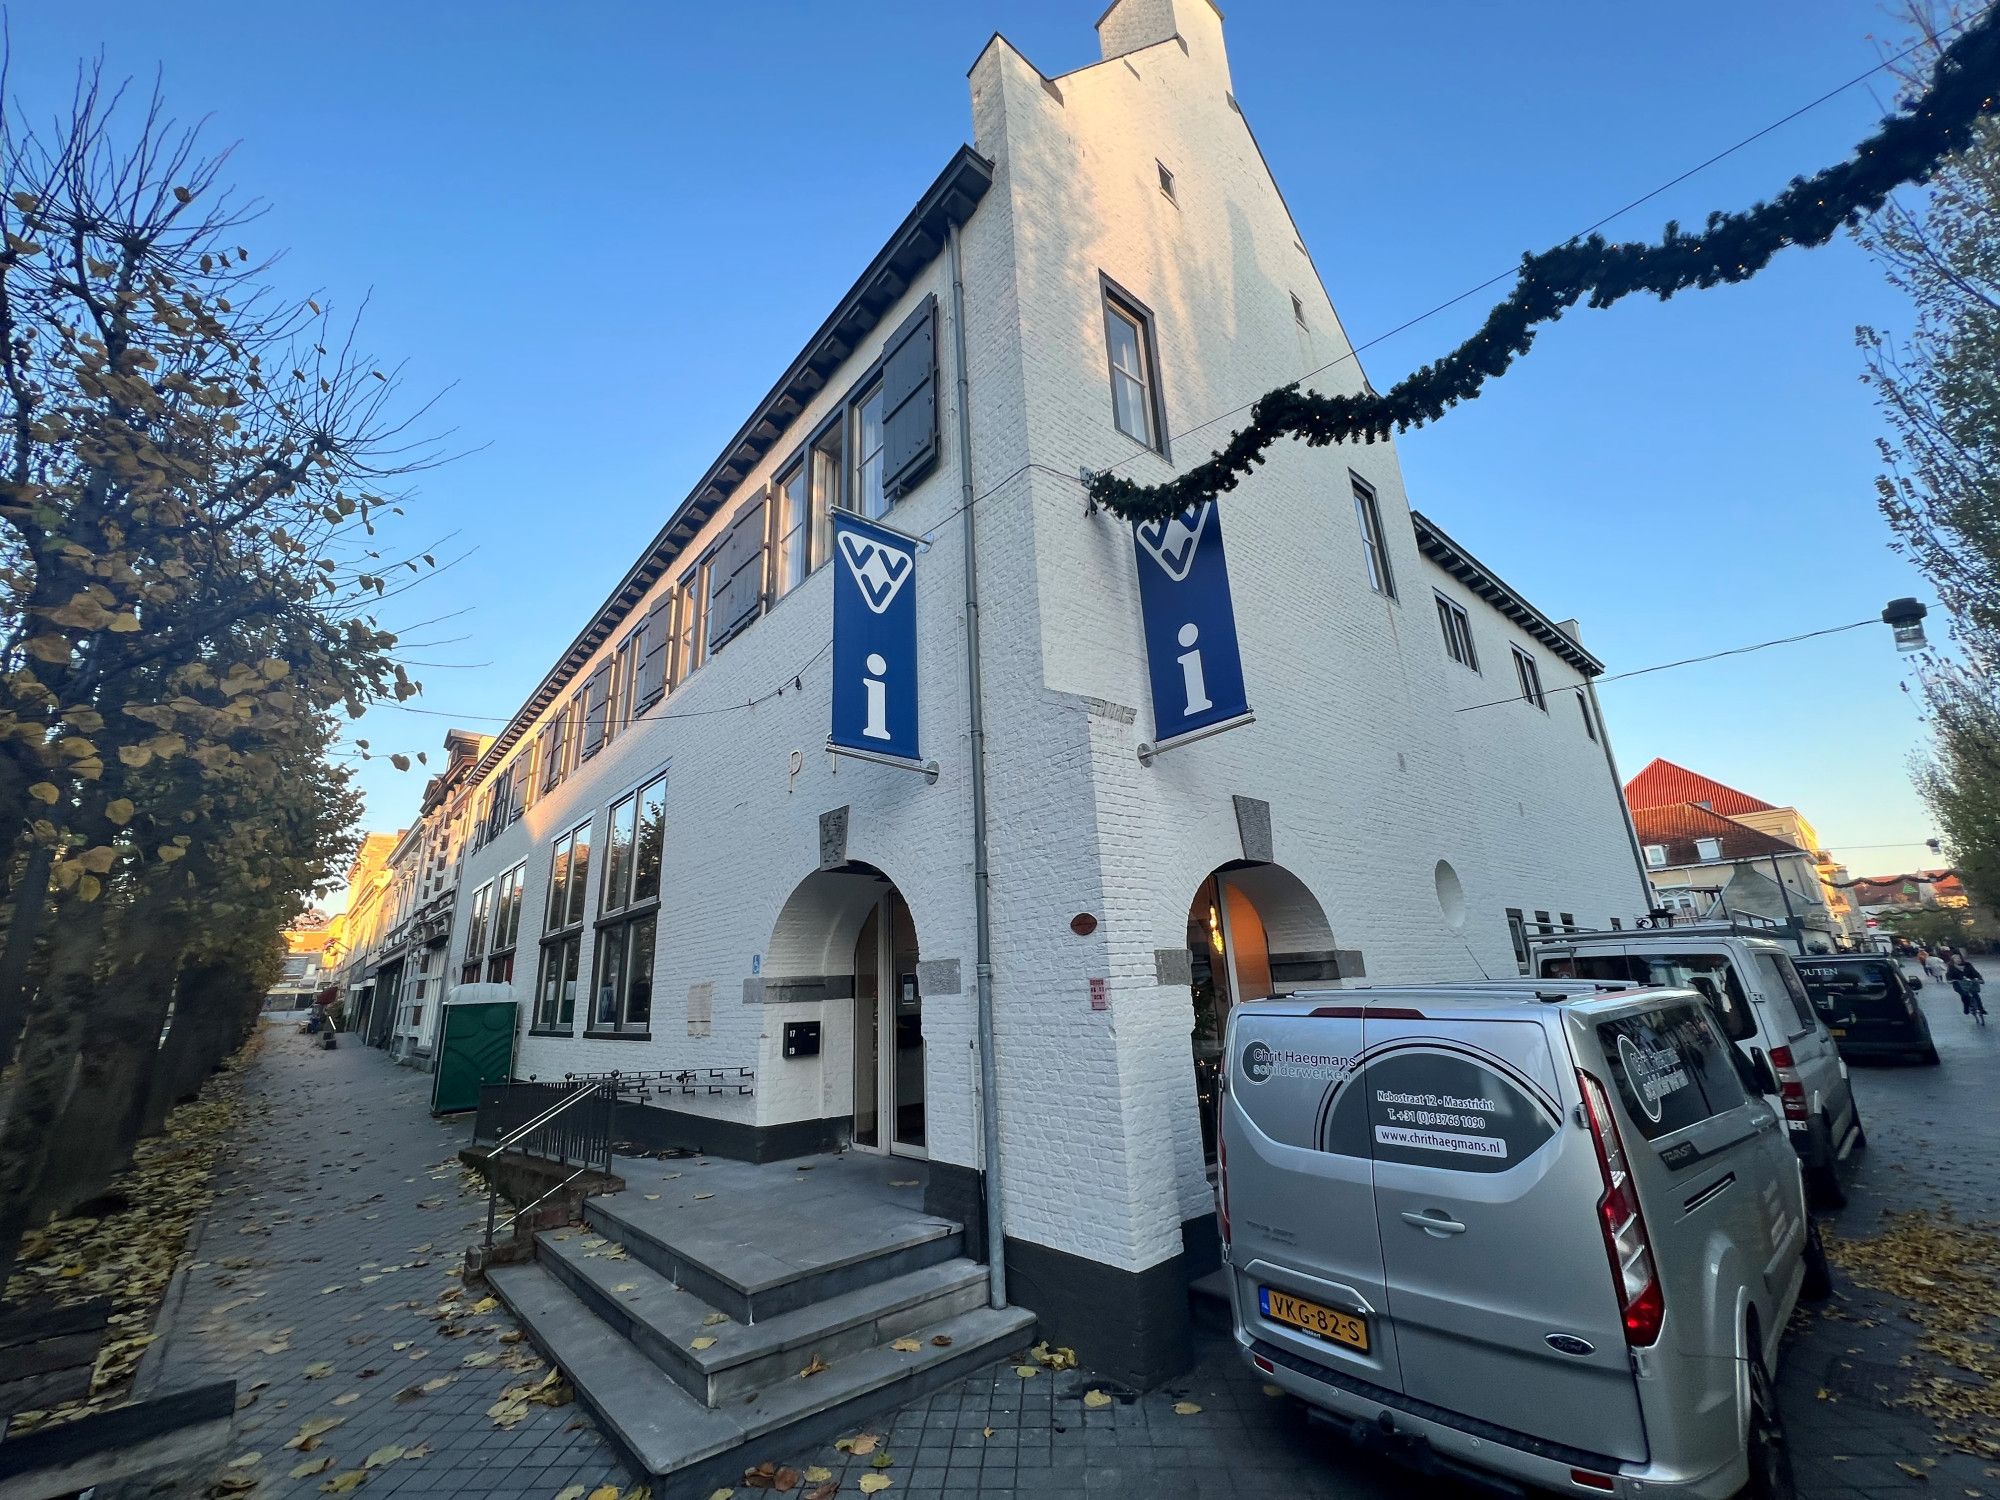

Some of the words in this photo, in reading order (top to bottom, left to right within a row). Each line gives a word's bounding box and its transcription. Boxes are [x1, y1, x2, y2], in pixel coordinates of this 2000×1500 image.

[1253, 1048, 1282, 1062] Chrit
[1285, 1051, 1356, 1067] Haegmans
[1253, 1062, 1351, 1081] schilderwerken
[1377, 1090, 1425, 1105] Nebostraat
[1425, 1094, 1437, 1106] 12
[1443, 1096, 1495, 1111] Maastricht
[1387, 1108, 1397, 1120] T.
[1397, 1110, 1416, 1123] +31
[1436, 1113, 1460, 1126] 3766
[1461, 1115, 1486, 1129] 1090
[1381, 1130, 1501, 1153] www.chrithaegmans.nl
[1273, 1294, 1360, 1342] VKG-82-S
